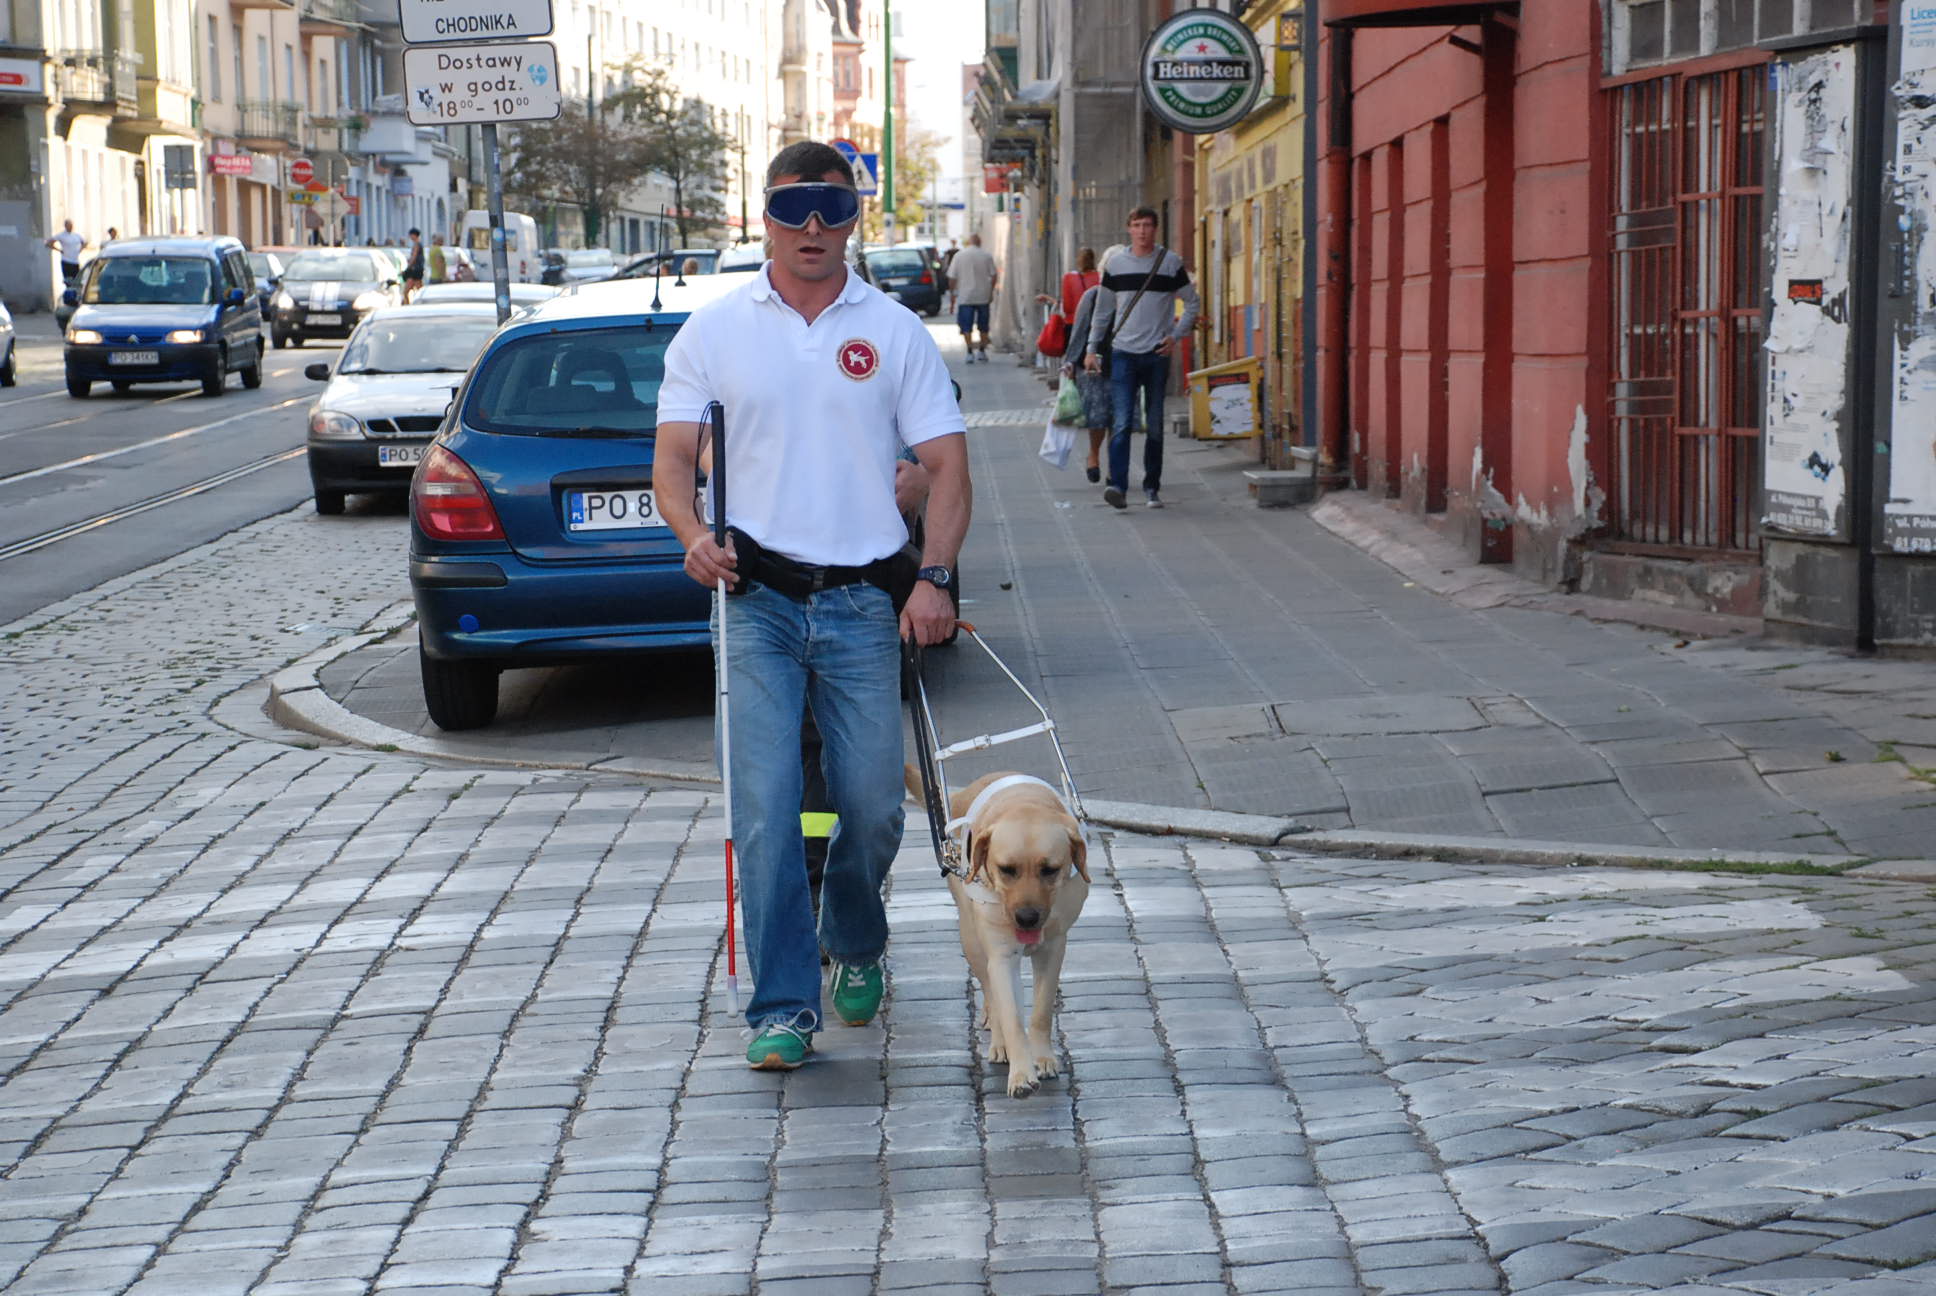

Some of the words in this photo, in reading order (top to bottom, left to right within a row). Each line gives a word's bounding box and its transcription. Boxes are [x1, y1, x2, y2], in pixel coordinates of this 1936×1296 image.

[435, 13, 518, 34] CHODNIKA
[438, 53, 523, 72] Dostawy
[1158, 62, 1245, 79] Heineken
[440, 82, 454, 94] w
[467, 75, 523, 97] godz.
[388, 447, 409, 462] PO
[572, 511, 583, 520] PL
[588, 494, 627, 521] PO
